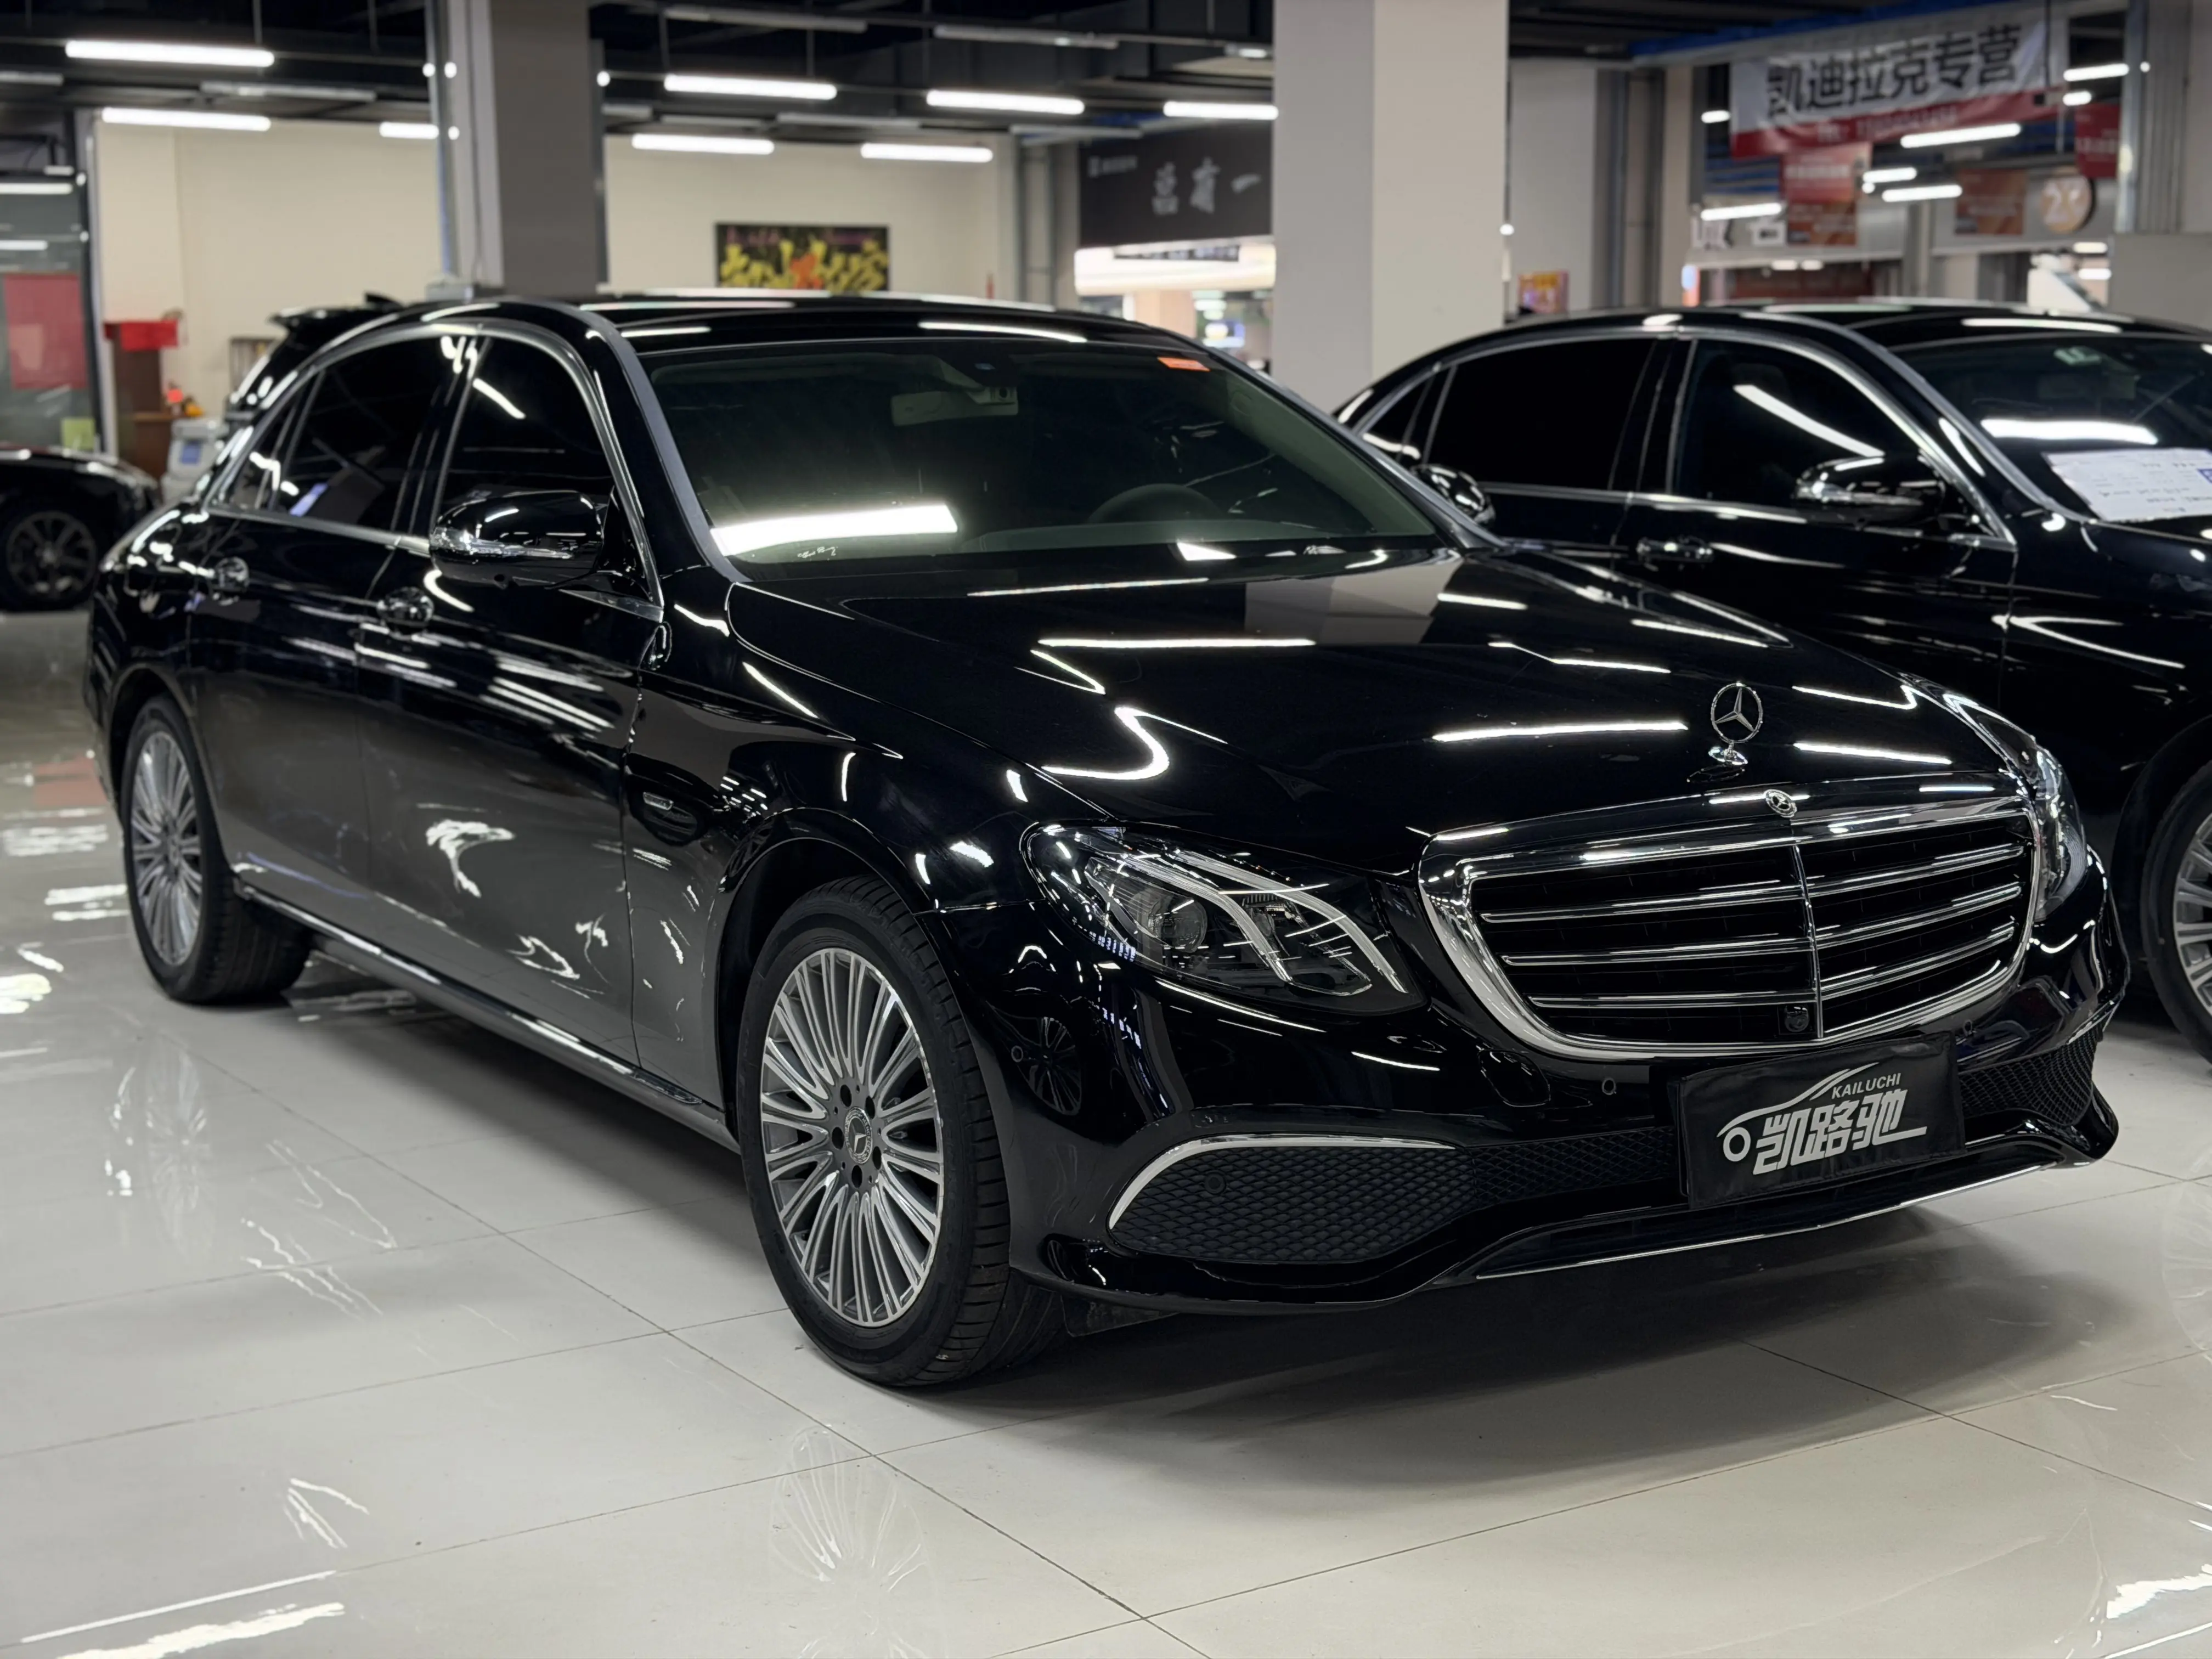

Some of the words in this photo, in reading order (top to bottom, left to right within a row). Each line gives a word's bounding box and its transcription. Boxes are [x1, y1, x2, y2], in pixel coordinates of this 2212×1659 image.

[1767, 24, 2022, 117] 凯迪拉克专营
[1831, 1073, 1901, 1099] KAILUCHI
[1753, 1088, 1927, 1175] 凯路驰
